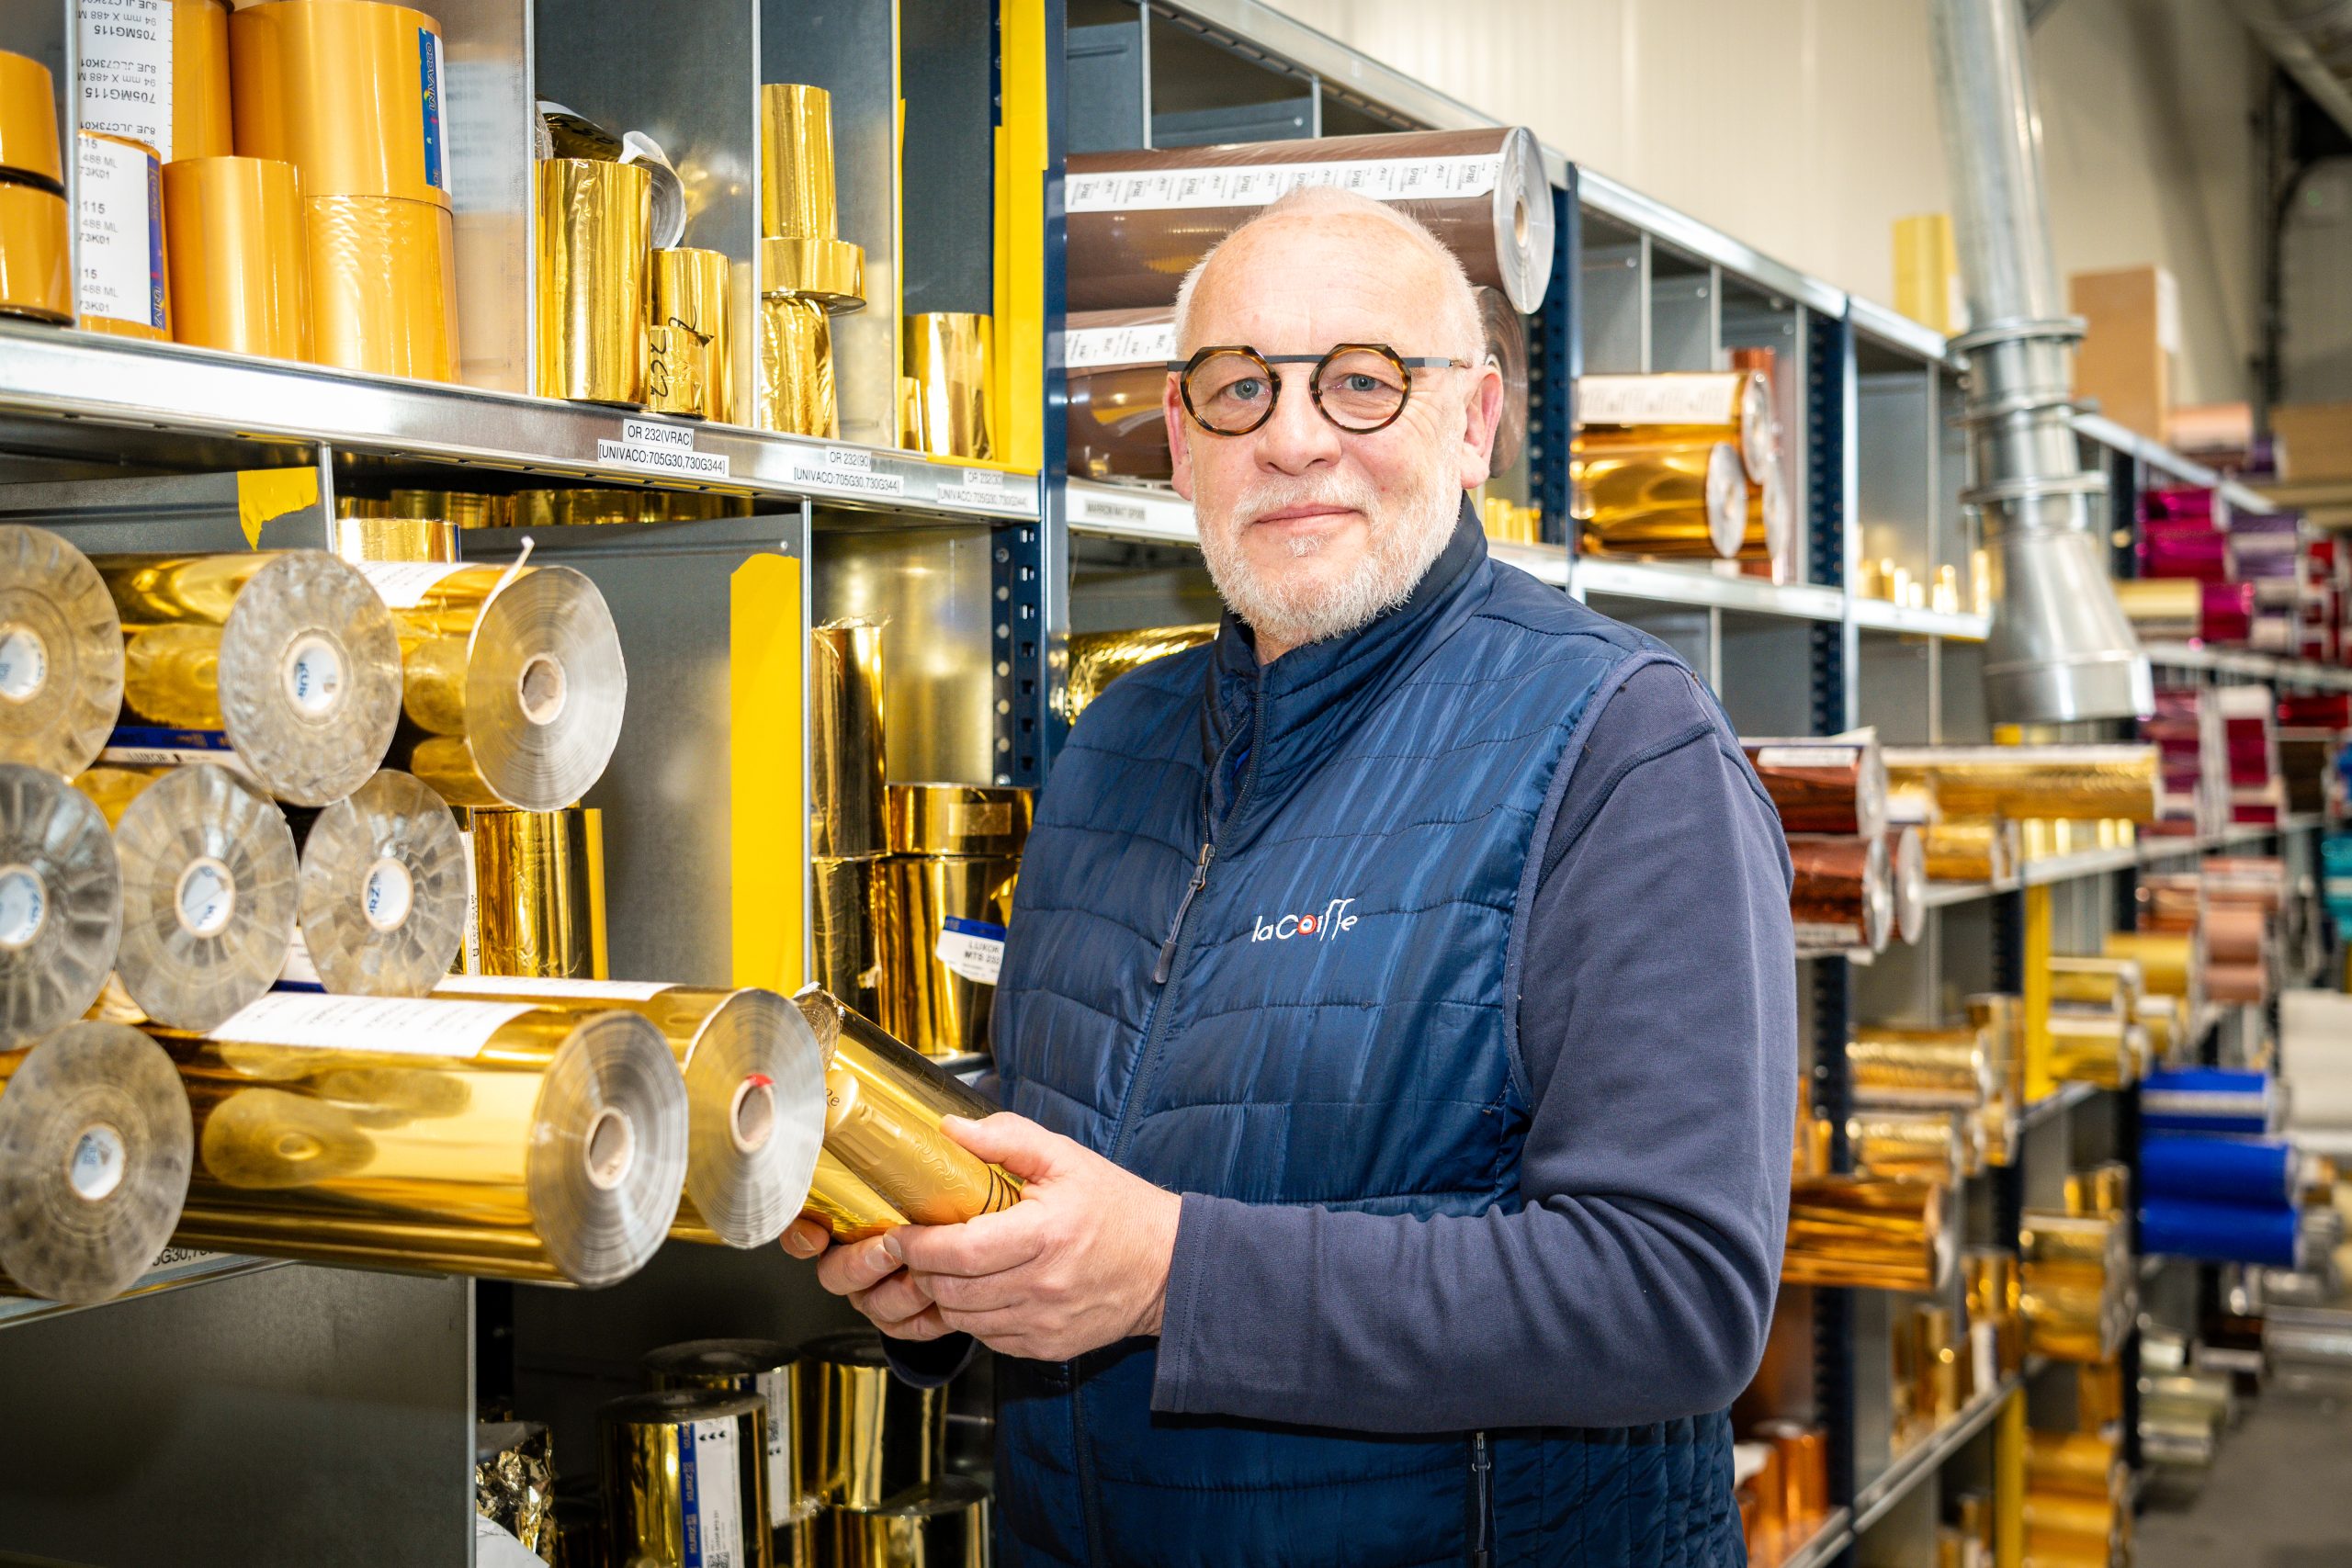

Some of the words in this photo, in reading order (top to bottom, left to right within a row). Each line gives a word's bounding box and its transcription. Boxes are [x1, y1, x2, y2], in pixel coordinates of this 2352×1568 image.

[90, 10, 109, 19] 488
[112, 12, 120, 21] X
[123, 13, 142, 22] mm
[94, 24, 156, 41] 705MG115
[111, 73, 119, 83] X
[122, 74, 141, 84] mm
[425, 42, 436, 111] UNIVACCO
[85, 87, 156, 104] 705MG115
[628, 424, 642, 439] OR
[645, 427, 693, 447] 232(VRAC)
[598, 444, 726, 475] [UNIVACO:705G30,730G344]
[830, 451, 842, 463] OR
[1251, 897, 1358, 942] laCoiffe
